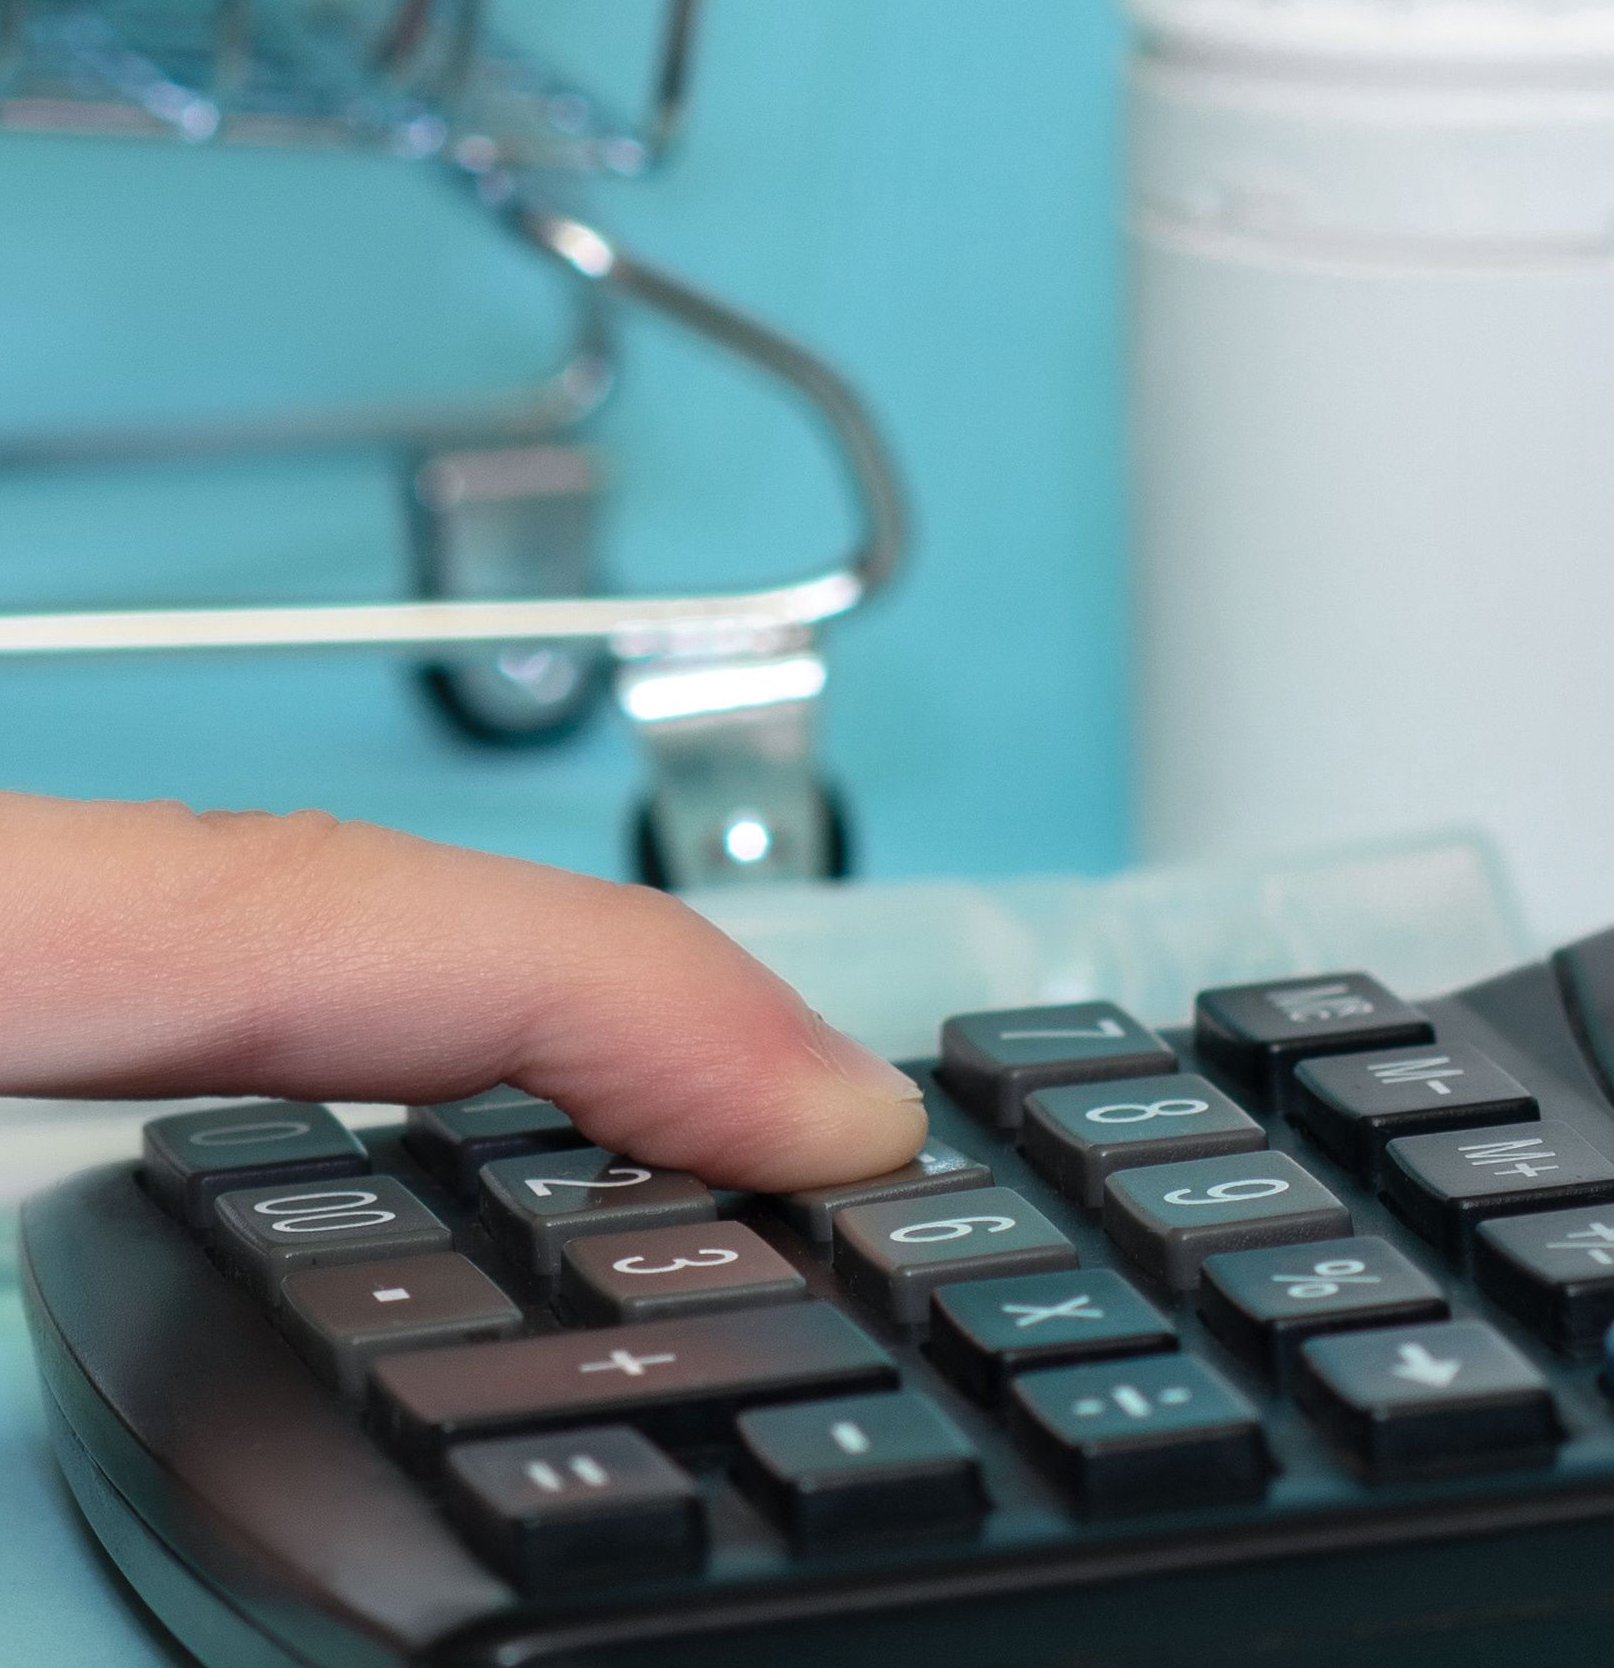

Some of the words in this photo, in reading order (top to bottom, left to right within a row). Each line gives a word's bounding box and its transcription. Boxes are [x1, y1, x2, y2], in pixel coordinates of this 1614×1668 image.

[1000, 1019, 1126, 1040] 7
[1085, 1098, 1209, 1124] 8
[190, 1121, 309, 1146] 0
[1457, 1137, 1558, 1178] M+
[524, 1167, 652, 1197] 2
[1164, 1178, 1289, 1205] 9
[254, 1191, 396, 1233] 00
[889, 1215, 1016, 1243] 6
[612, 1248, 739, 1275] 3
